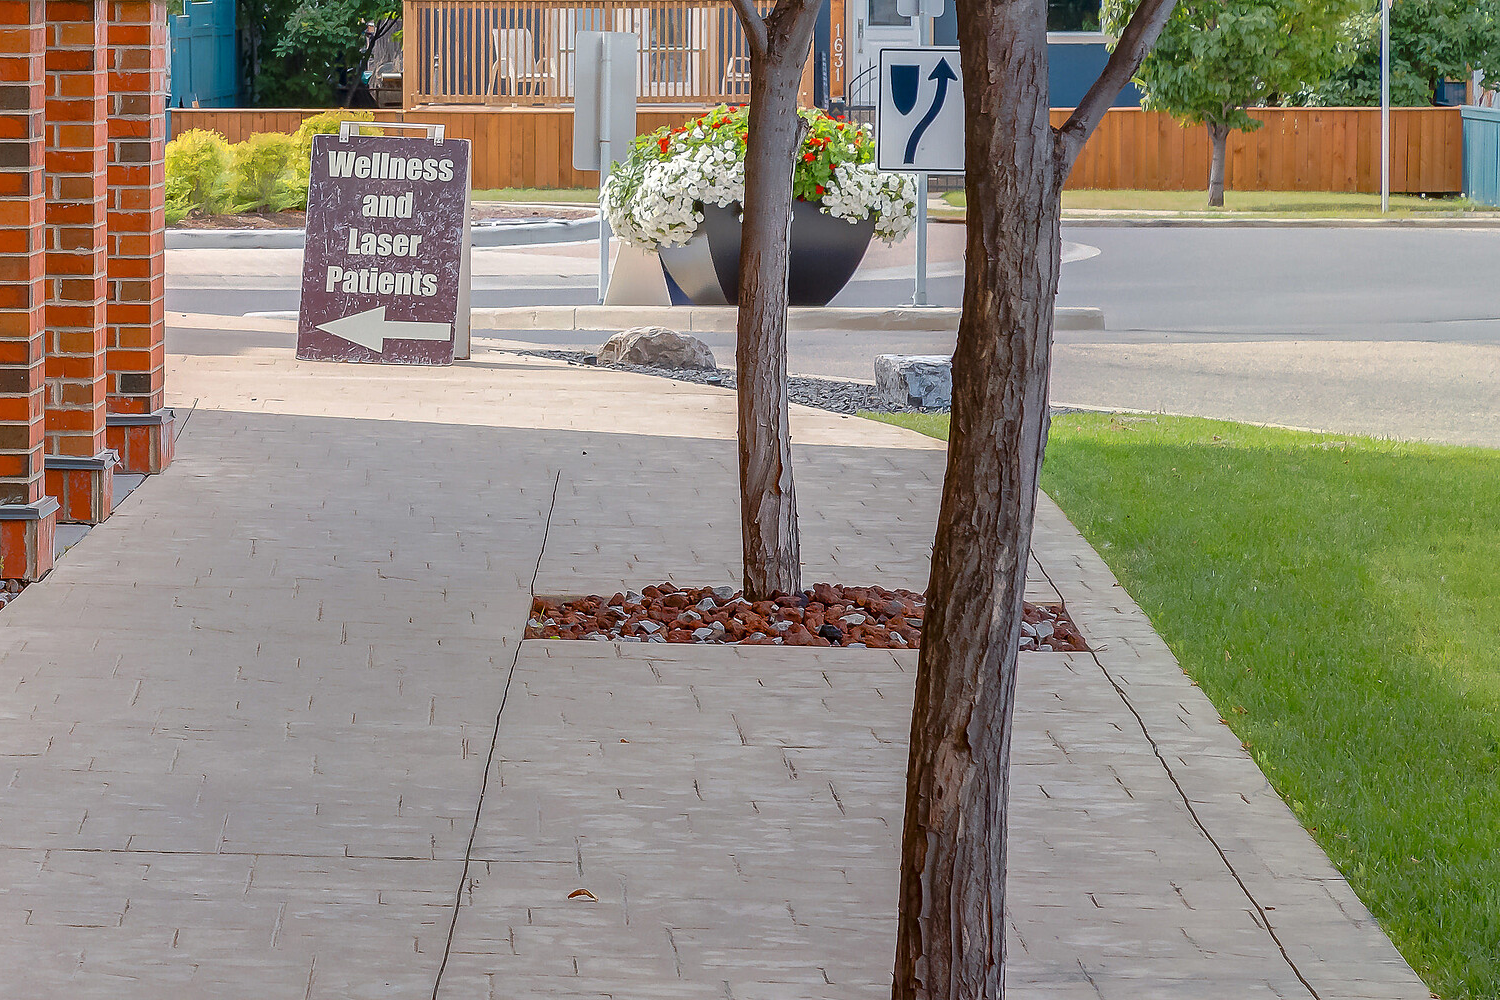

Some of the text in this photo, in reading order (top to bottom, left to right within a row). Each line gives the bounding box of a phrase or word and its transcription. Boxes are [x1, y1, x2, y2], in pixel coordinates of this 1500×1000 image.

[833, 23, 844, 82] 1631
[328, 150, 455, 182] Wellness
[361, 191, 414, 219] and
[347, 227, 423, 258] Laser
[325, 265, 439, 297] Patients
